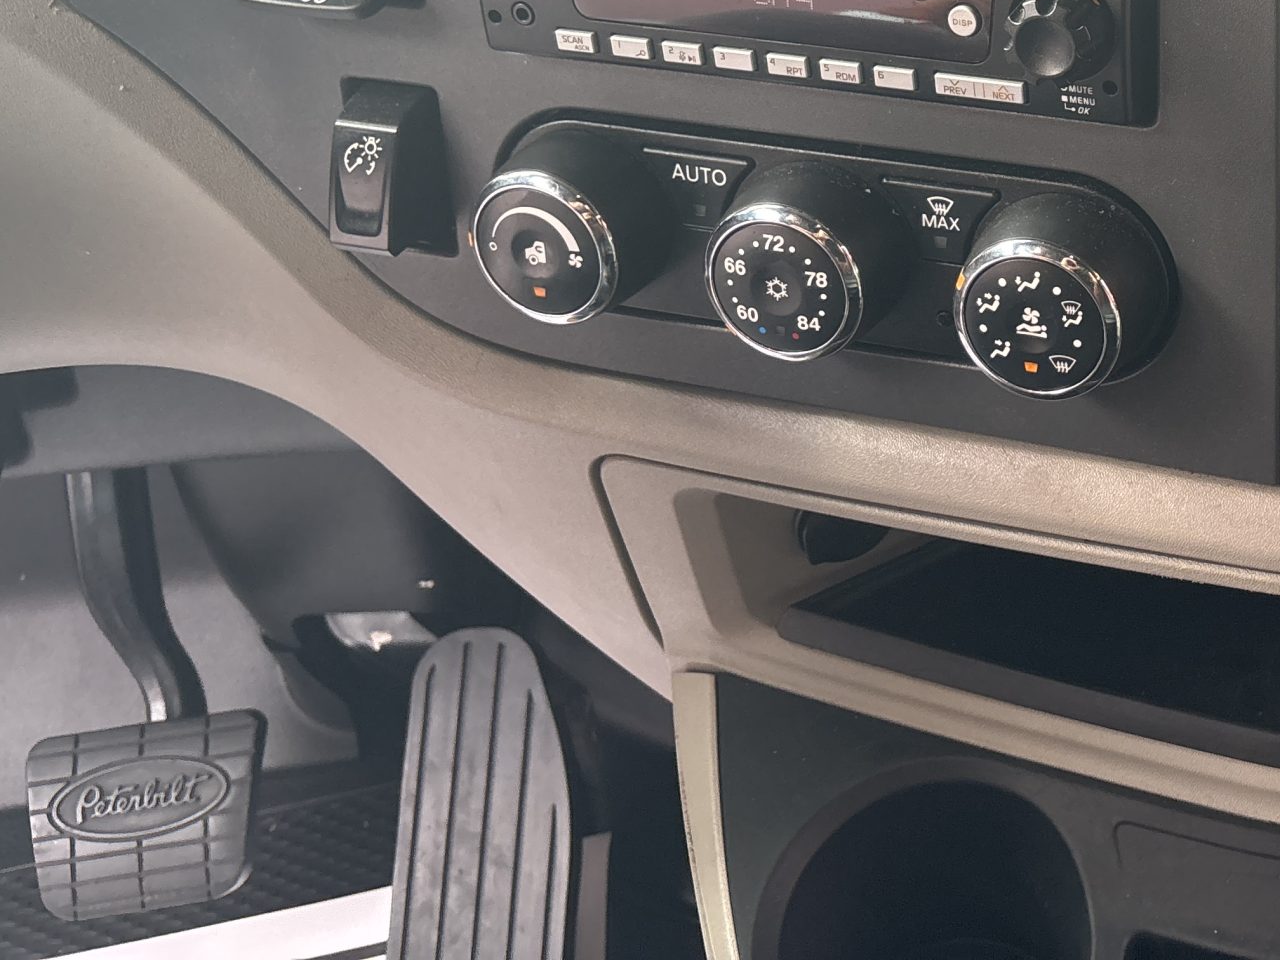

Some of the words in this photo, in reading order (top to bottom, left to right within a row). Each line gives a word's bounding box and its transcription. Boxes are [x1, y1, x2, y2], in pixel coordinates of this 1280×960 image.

[561, 35, 584, 45] SCAN
[668, 46, 675, 55] 2
[719, 52, 726, 61] 3
[769, 57, 776, 66] 4
[786, 66, 803, 76] RPT
[823, 63, 830, 72] 5
[835, 71, 857, 82] RDM
[877, 70, 885, 80] 6
[943, 85, 967, 96] PREV
[1069, 84, 1093, 95] MUTE
[992, 92, 1017, 102] NEXT
[1069, 96, 1096, 107] MENU
[1077, 106, 1091, 115] OK
[672, 163, 727, 187] AUTO
[922, 213, 960, 231] MAX
[762, 234, 785, 253] 72
[724, 257, 746, 276] 66
[804, 271, 828, 288] 78
[736, 305, 759, 323] 60
[797, 315, 821, 332] 84
[75, 772, 213, 825] Peterbilt
